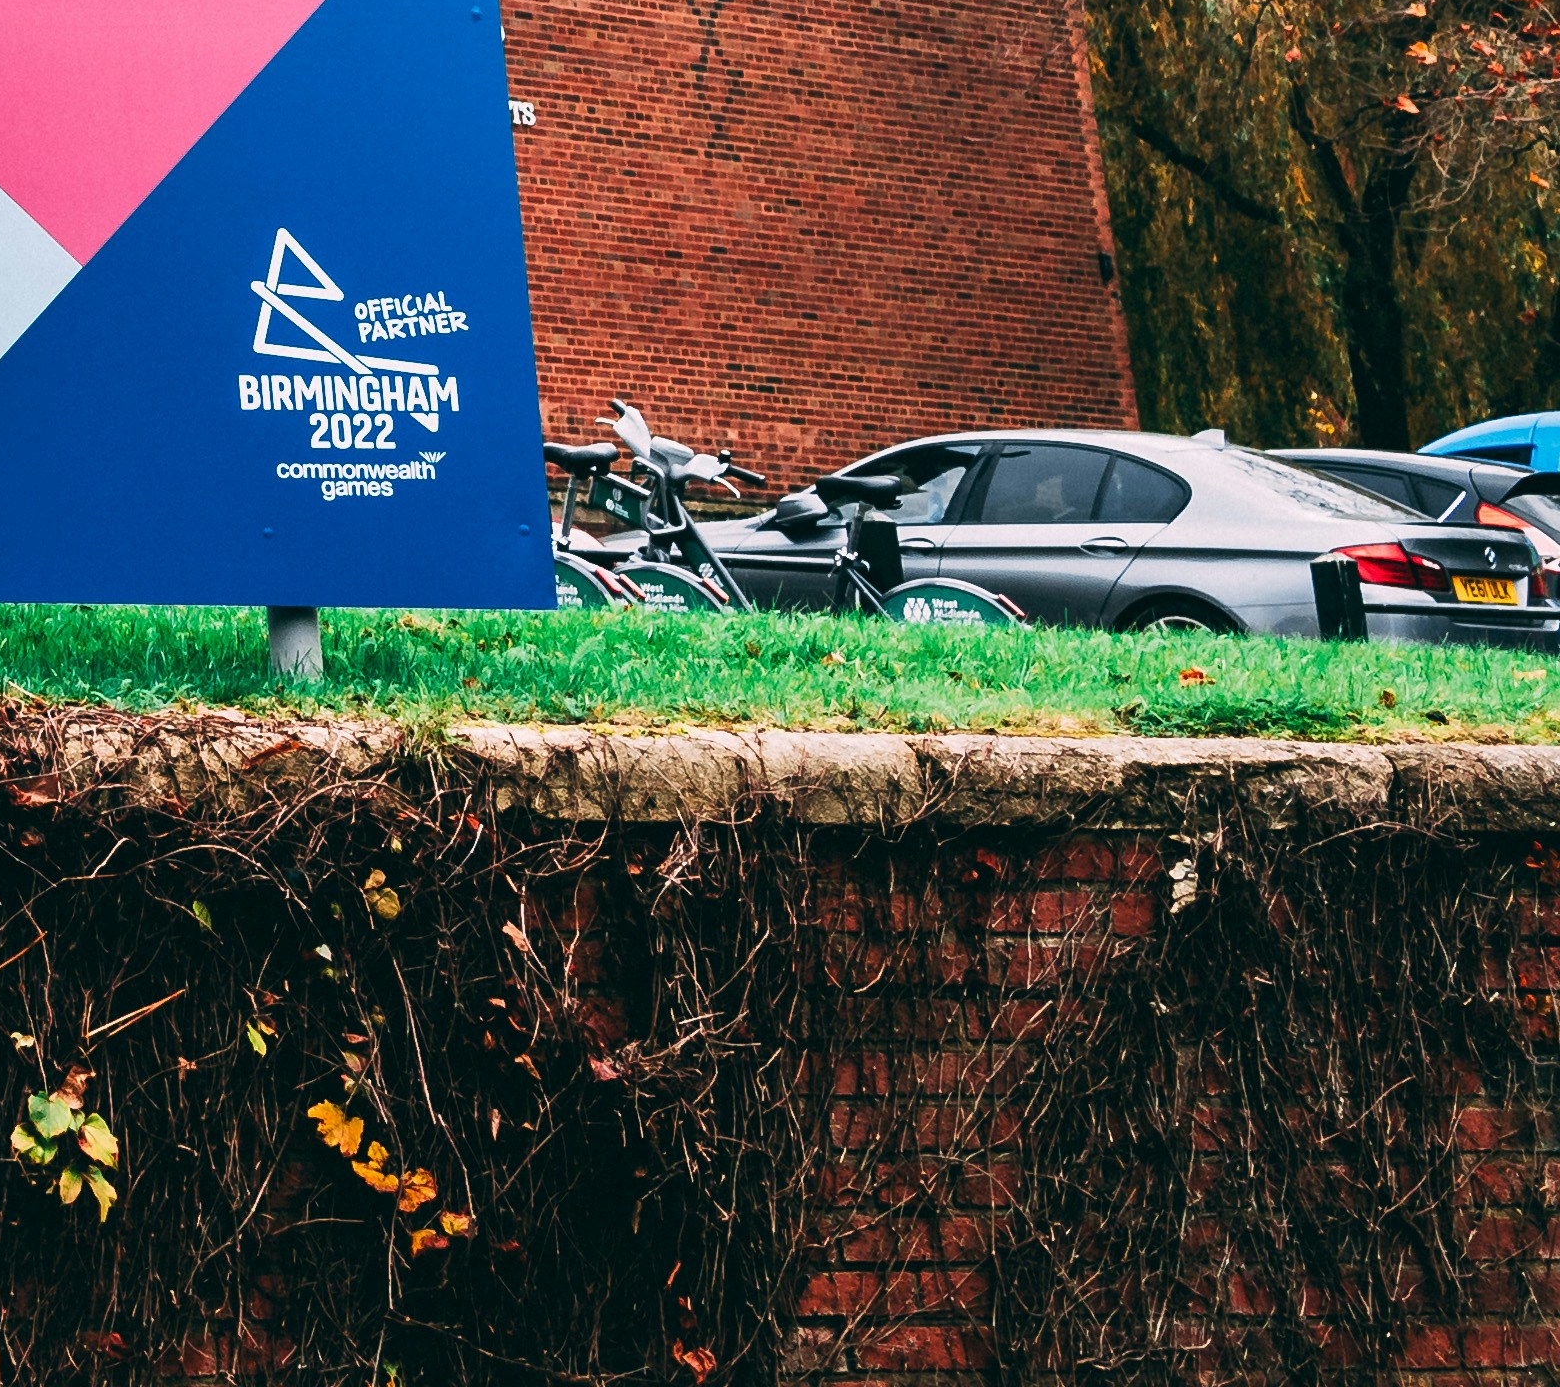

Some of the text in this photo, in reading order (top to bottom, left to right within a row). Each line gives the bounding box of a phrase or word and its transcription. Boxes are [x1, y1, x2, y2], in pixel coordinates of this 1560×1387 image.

[354, 290, 453, 321] OFFICIAL
[357, 311, 470, 344] PARTNER
[238, 374, 460, 412] BIRMINGHAM
[309, 412, 397, 450] 2022
[276, 460, 436, 480] commonwealth
[321, 480, 394, 502] games
